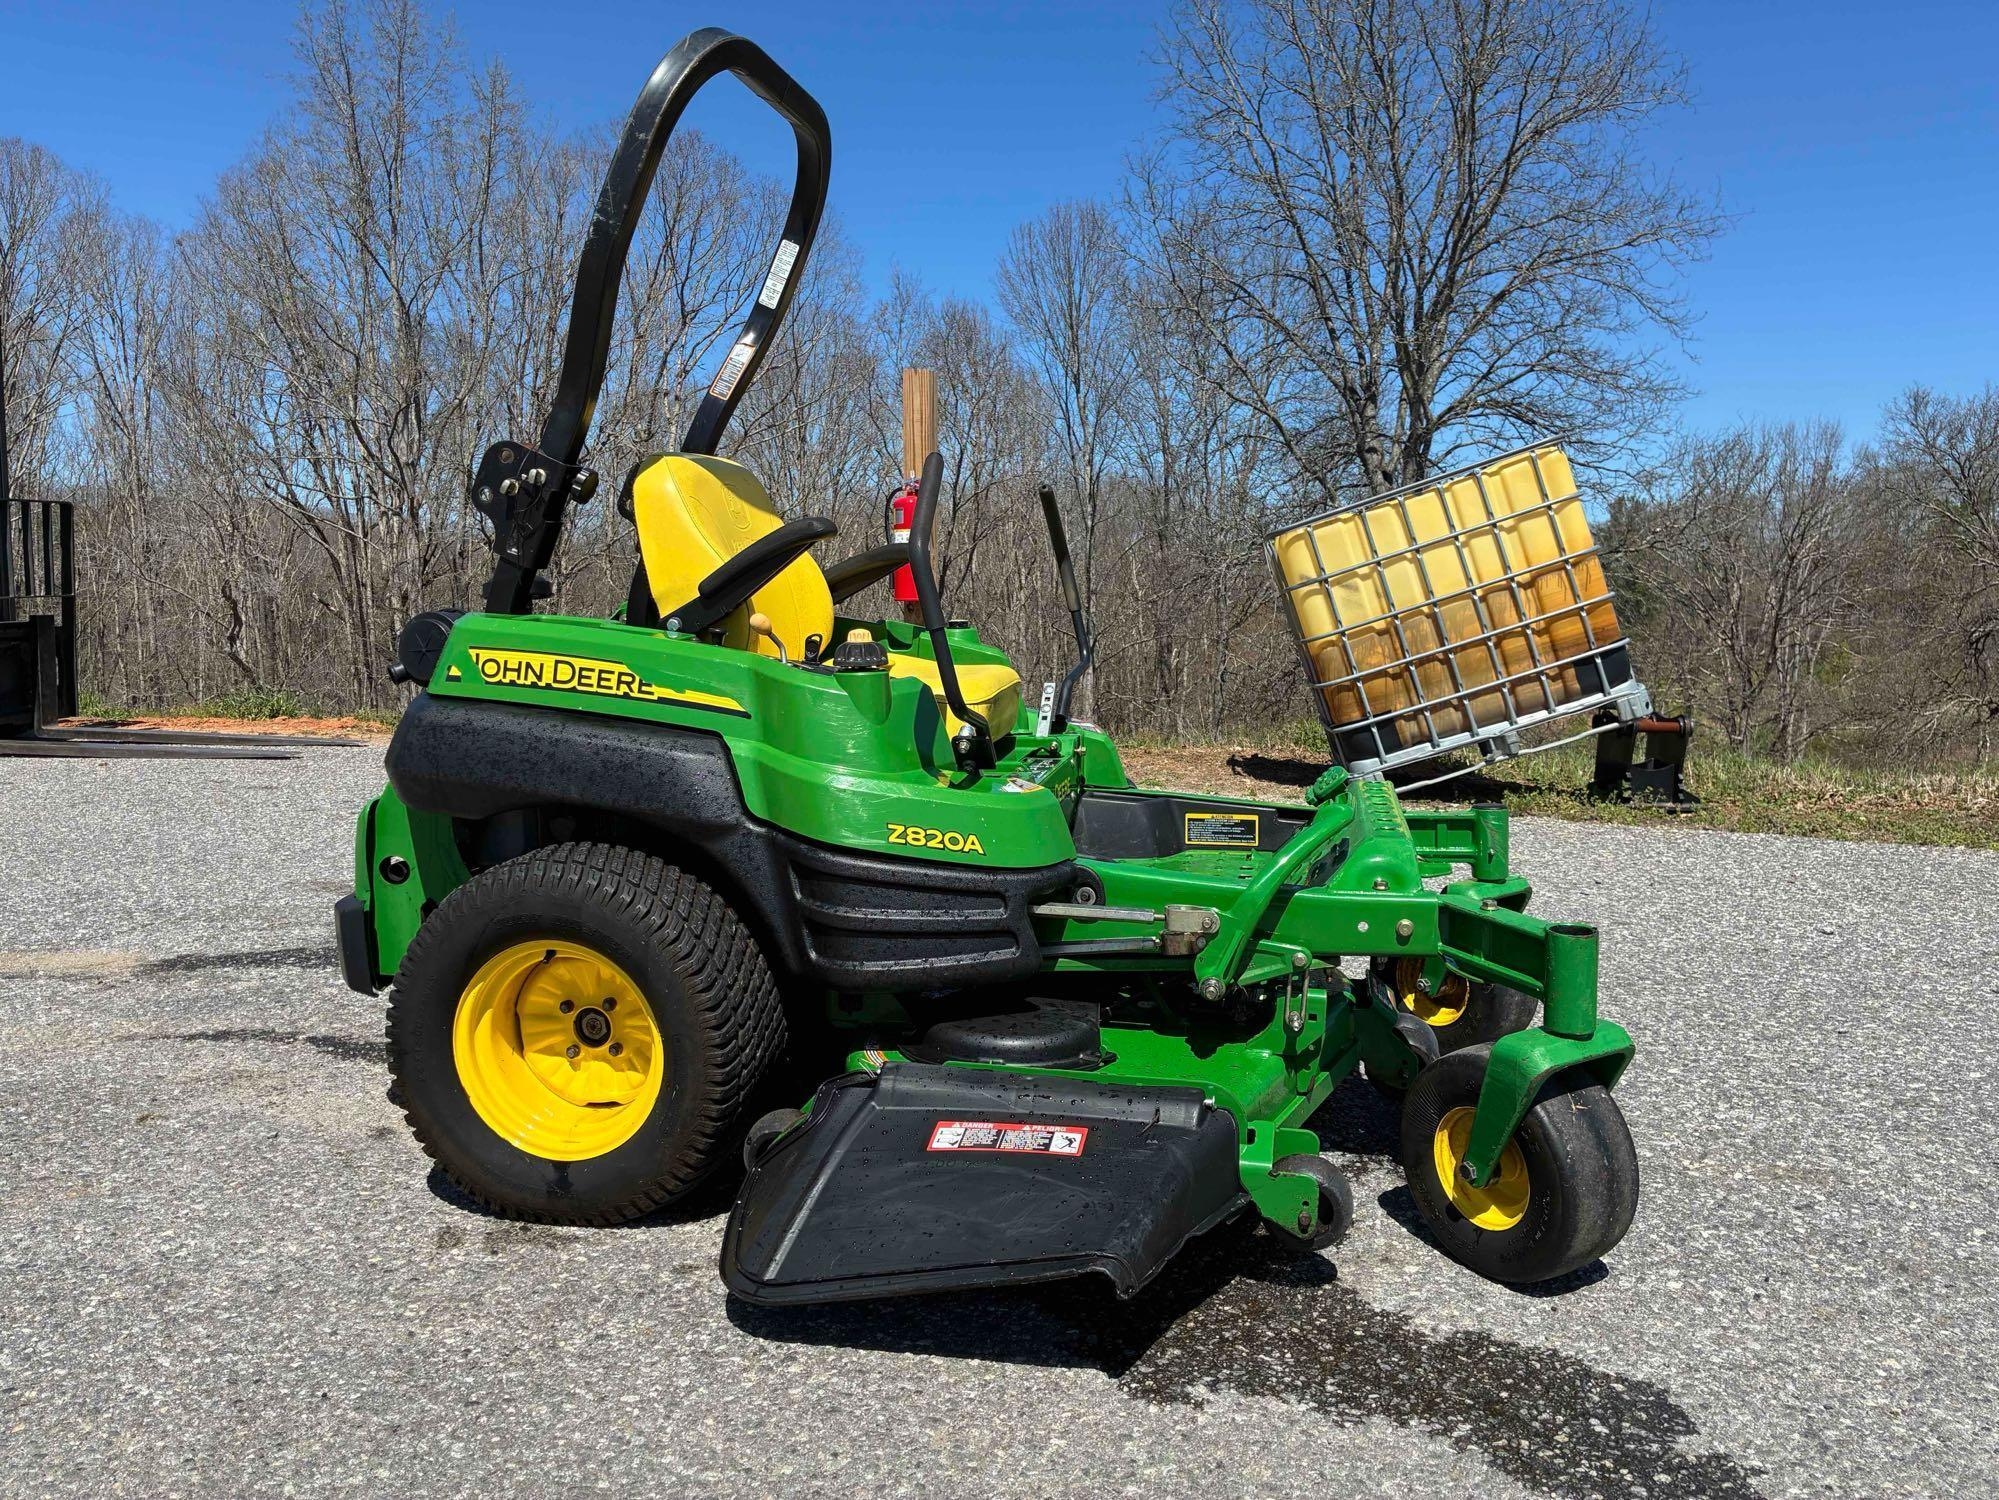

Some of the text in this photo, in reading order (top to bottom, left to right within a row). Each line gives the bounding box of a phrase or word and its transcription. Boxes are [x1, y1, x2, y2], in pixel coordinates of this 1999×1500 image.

[552, 659, 655, 697] DEERE
[887, 823, 986, 856] Z820A
[961, 1121, 994, 1129] DANGER
[1031, 1124, 1067, 1133] PELIGRO
